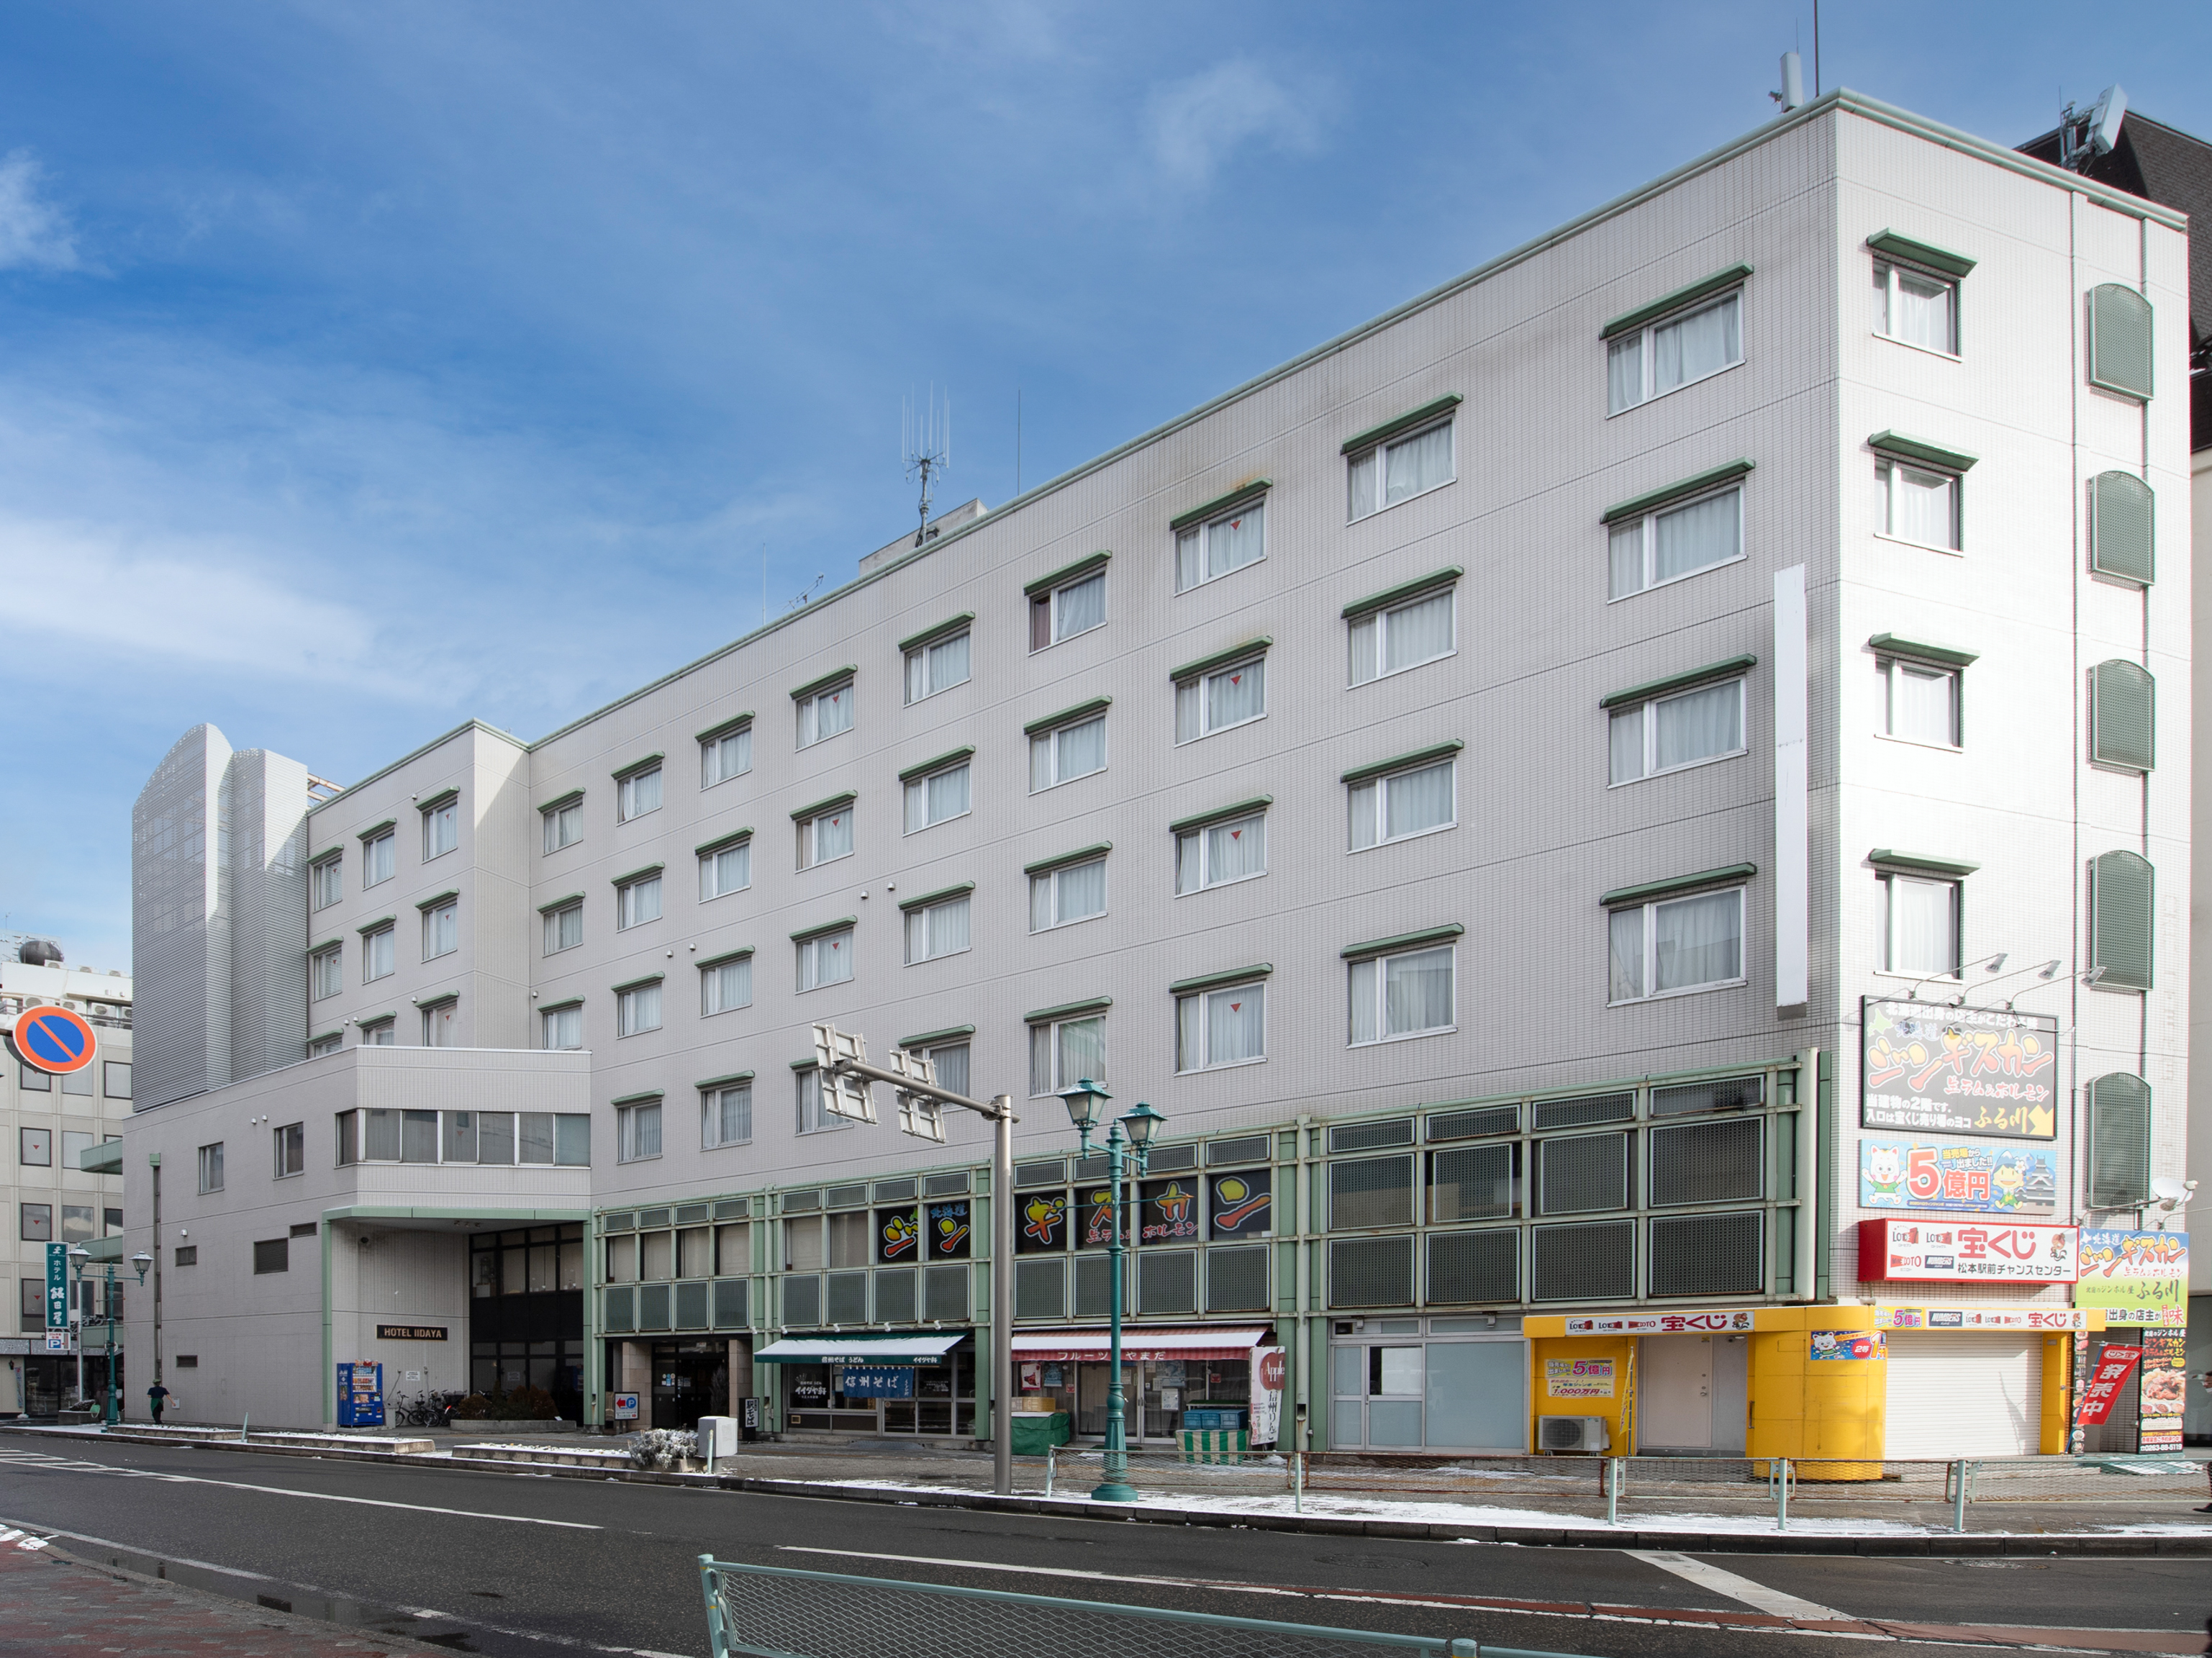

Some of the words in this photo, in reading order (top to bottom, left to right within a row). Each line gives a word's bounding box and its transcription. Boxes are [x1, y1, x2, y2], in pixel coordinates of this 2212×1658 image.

[1895, 1020, 1940, 1041] 北海道
[1868, 1026, 2054, 1092] ジンギスカン
[1866, 1108, 1972, 1128] 入口は宝くじ売り場のヨコ
[1974, 1105, 2028, 1134] ふる川
[1942, 1147, 1980, 1160] 当売場から
[930, 1203, 968, 1219] 北海道
[1957, 1227, 2036, 1259] 宝くじ
[2093, 1233, 2121, 1246] 北海道
[2080, 1236, 2186, 1278] ジンギスカン
[53, 1259, 62, 1281] ホテル
[1957, 1262, 2071, 1276] 松本駅前チャンスセンター
[2136, 1279, 2179, 1303] ふる川
[1661, 1315, 1727, 1331] 宝くじ
[2028, 1312, 2067, 1328] 宝くじ
[2106, 1308, 2162, 1321] 出身の店主が
[2169, 1305, 2185, 1326] 味
[384, 1328, 412, 1337] HOTEL
[414, 1328, 442, 1338] IIDAYA
[2144, 1338, 2186, 1348] ジンギスカン
[1057, 1351, 1108, 1360] フルーツ
[1125, 1351, 1166, 1360] やまだ
[1264, 1360, 1285, 1382] Apple
[1572, 1360, 1612, 1377] 5億円
[845, 1375, 899, 1389] 信州そば
[1268, 1390, 1278, 1440] 信州りんご
